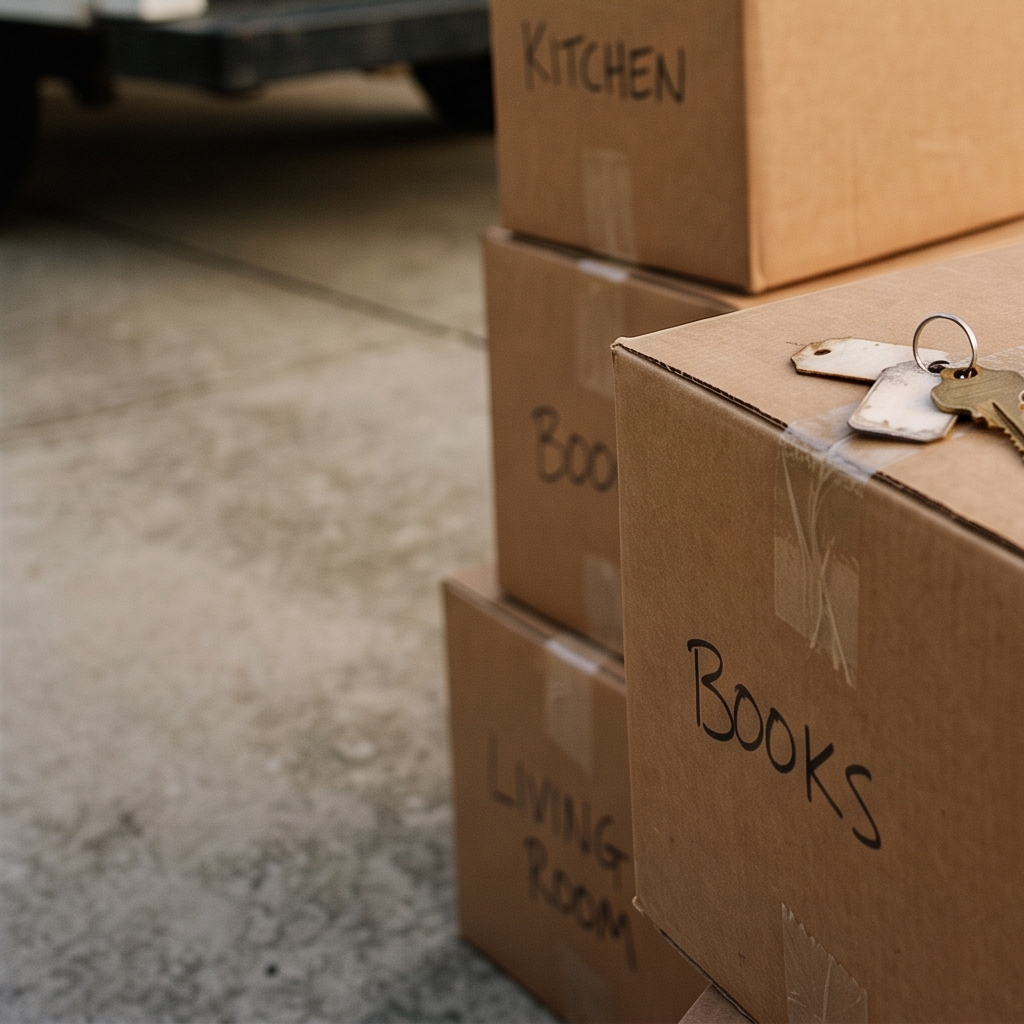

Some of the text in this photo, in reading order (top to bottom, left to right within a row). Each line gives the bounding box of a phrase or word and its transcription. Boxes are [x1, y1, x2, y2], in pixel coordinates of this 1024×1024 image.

[520, 20, 687, 105] KITCHEN
[487, 732, 631, 888] LIVING
[686, 638, 882, 850] BOOKS
[523, 836, 638, 973] ROOM
